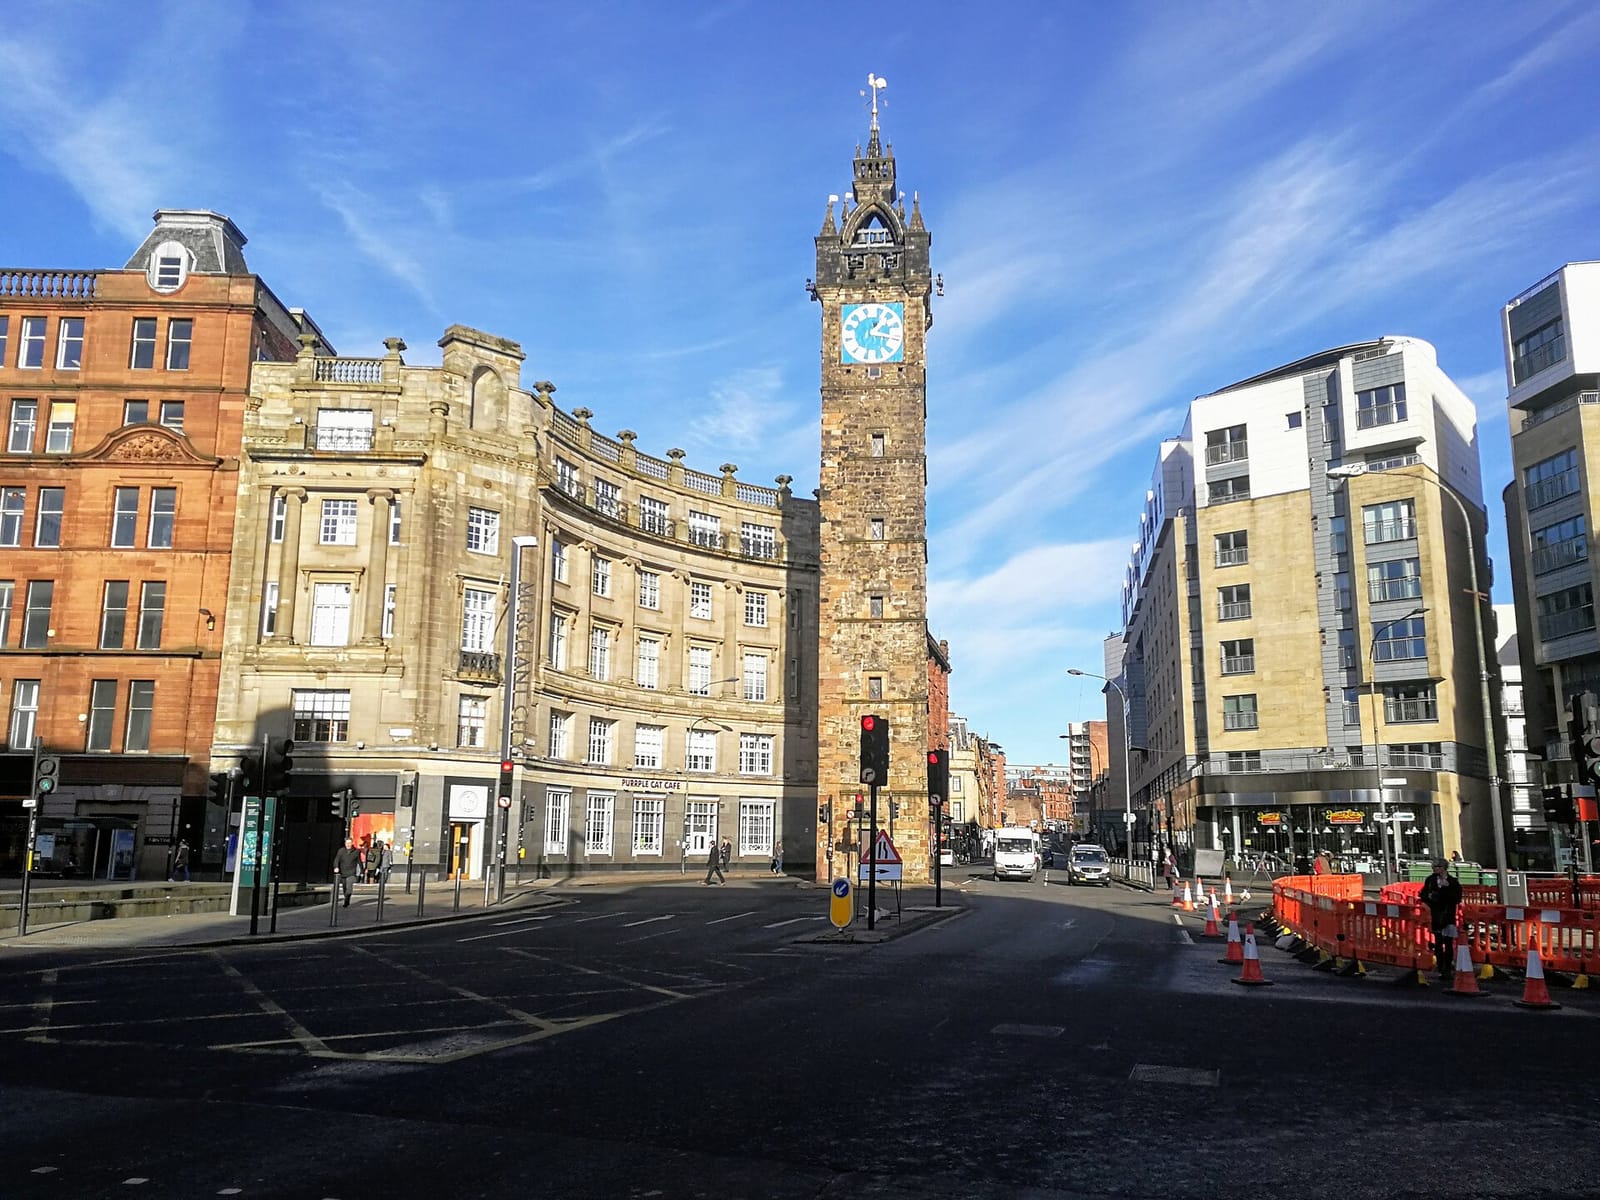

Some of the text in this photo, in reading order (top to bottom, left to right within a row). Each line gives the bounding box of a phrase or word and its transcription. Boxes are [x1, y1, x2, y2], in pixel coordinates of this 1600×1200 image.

[513, 582, 534, 751] MERCHANT CITY
[621, 779, 649, 788] PURRPLE
[664, 782, 681, 790] CAFE
